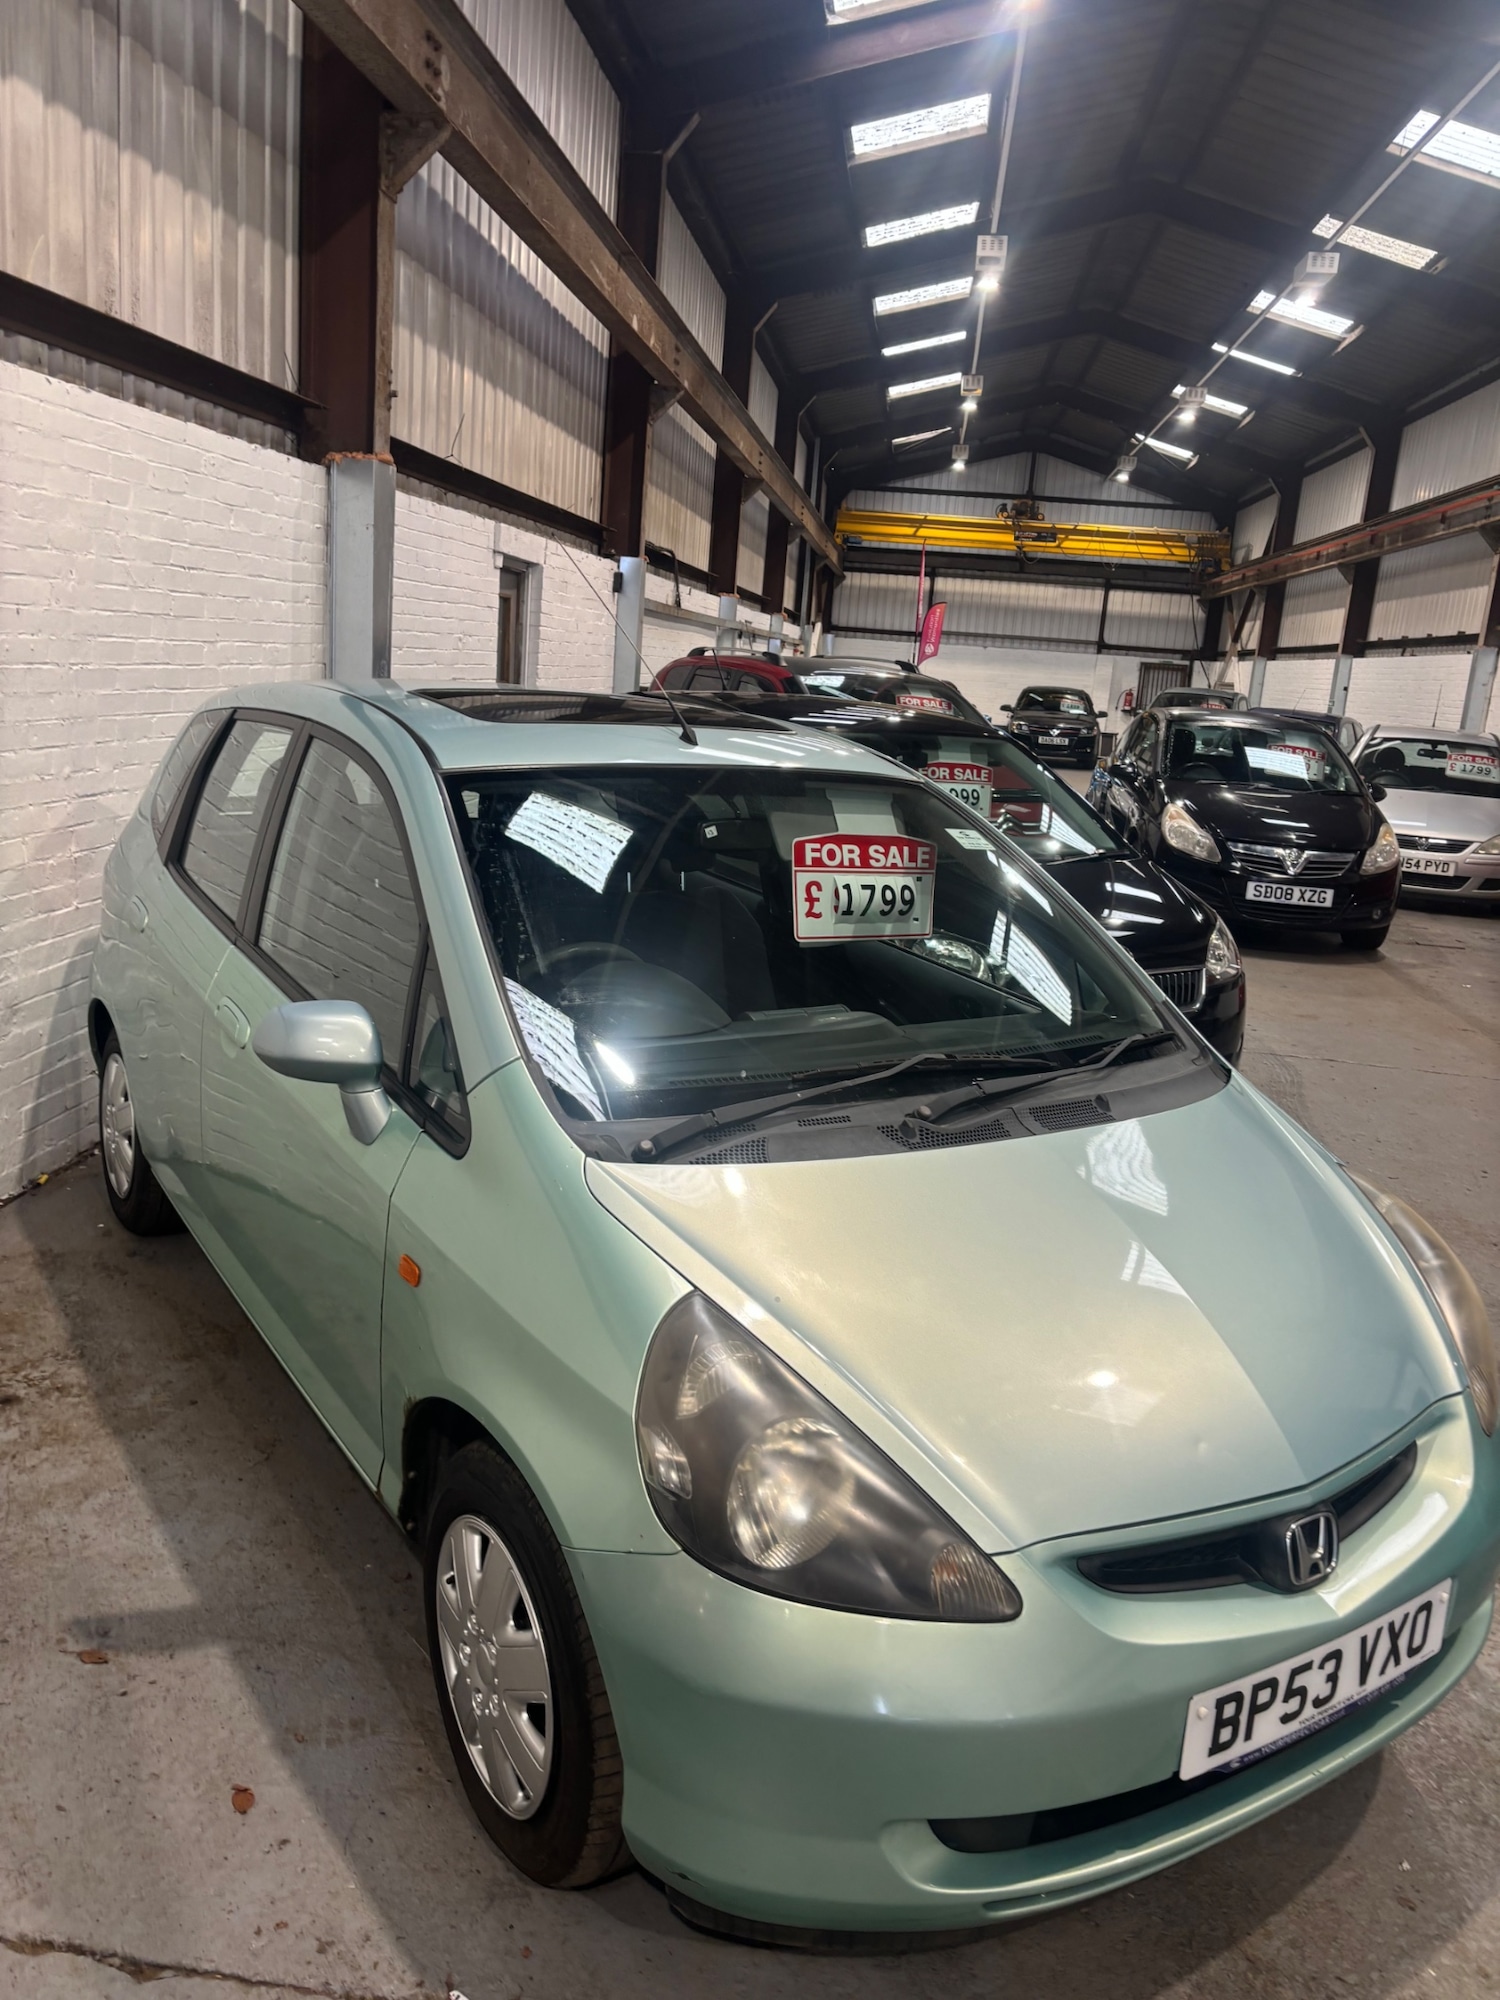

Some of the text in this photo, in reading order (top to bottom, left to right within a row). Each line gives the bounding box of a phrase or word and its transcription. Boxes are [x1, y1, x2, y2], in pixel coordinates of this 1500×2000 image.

[900, 696, 949, 709] FOR SALE
[1296, 749, 1322, 760] SALE
[1451, 754, 1473, 763] FOR
[918, 767, 989, 781] FOR SALE
[1449, 762, 1492, 776] £ 1799
[804, 842, 931, 868] FOR SALE
[1423, 861, 1450, 873] PYD
[804, 880, 915, 919] £ 1799
[1253, 884, 1327, 904] SD08 XZG
[1207, 1648, 1343, 1758] BP53
[1359, 1600, 1433, 1687] VXO
